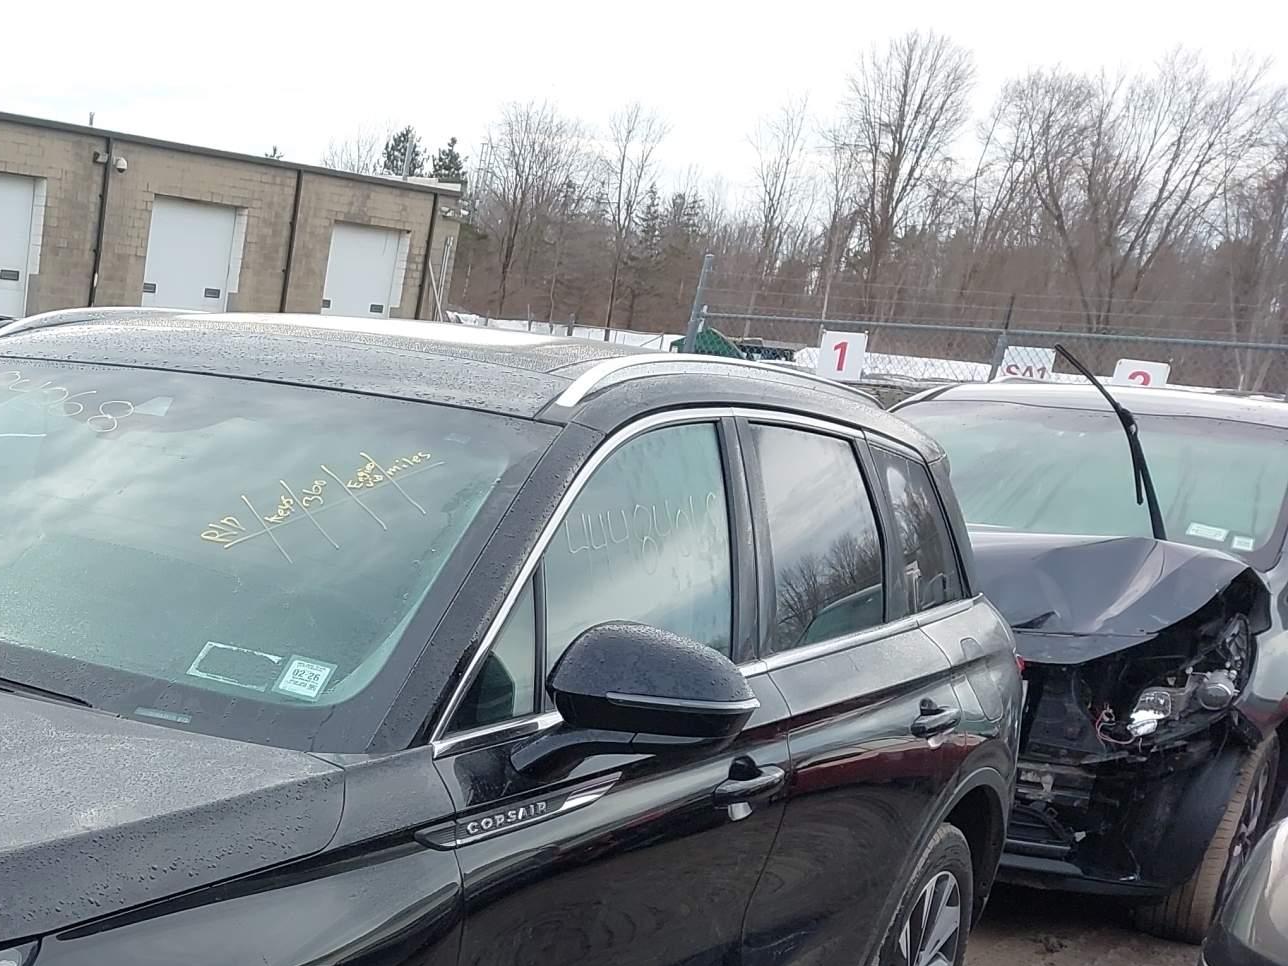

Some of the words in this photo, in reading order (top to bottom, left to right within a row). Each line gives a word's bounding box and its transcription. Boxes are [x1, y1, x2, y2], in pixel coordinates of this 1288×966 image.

[833, 341, 849, 371] 1
[386, 451, 432, 477] miles
[292, 668, 321, 681] 02-26
[466, 801, 547, 835] CORSAIR
